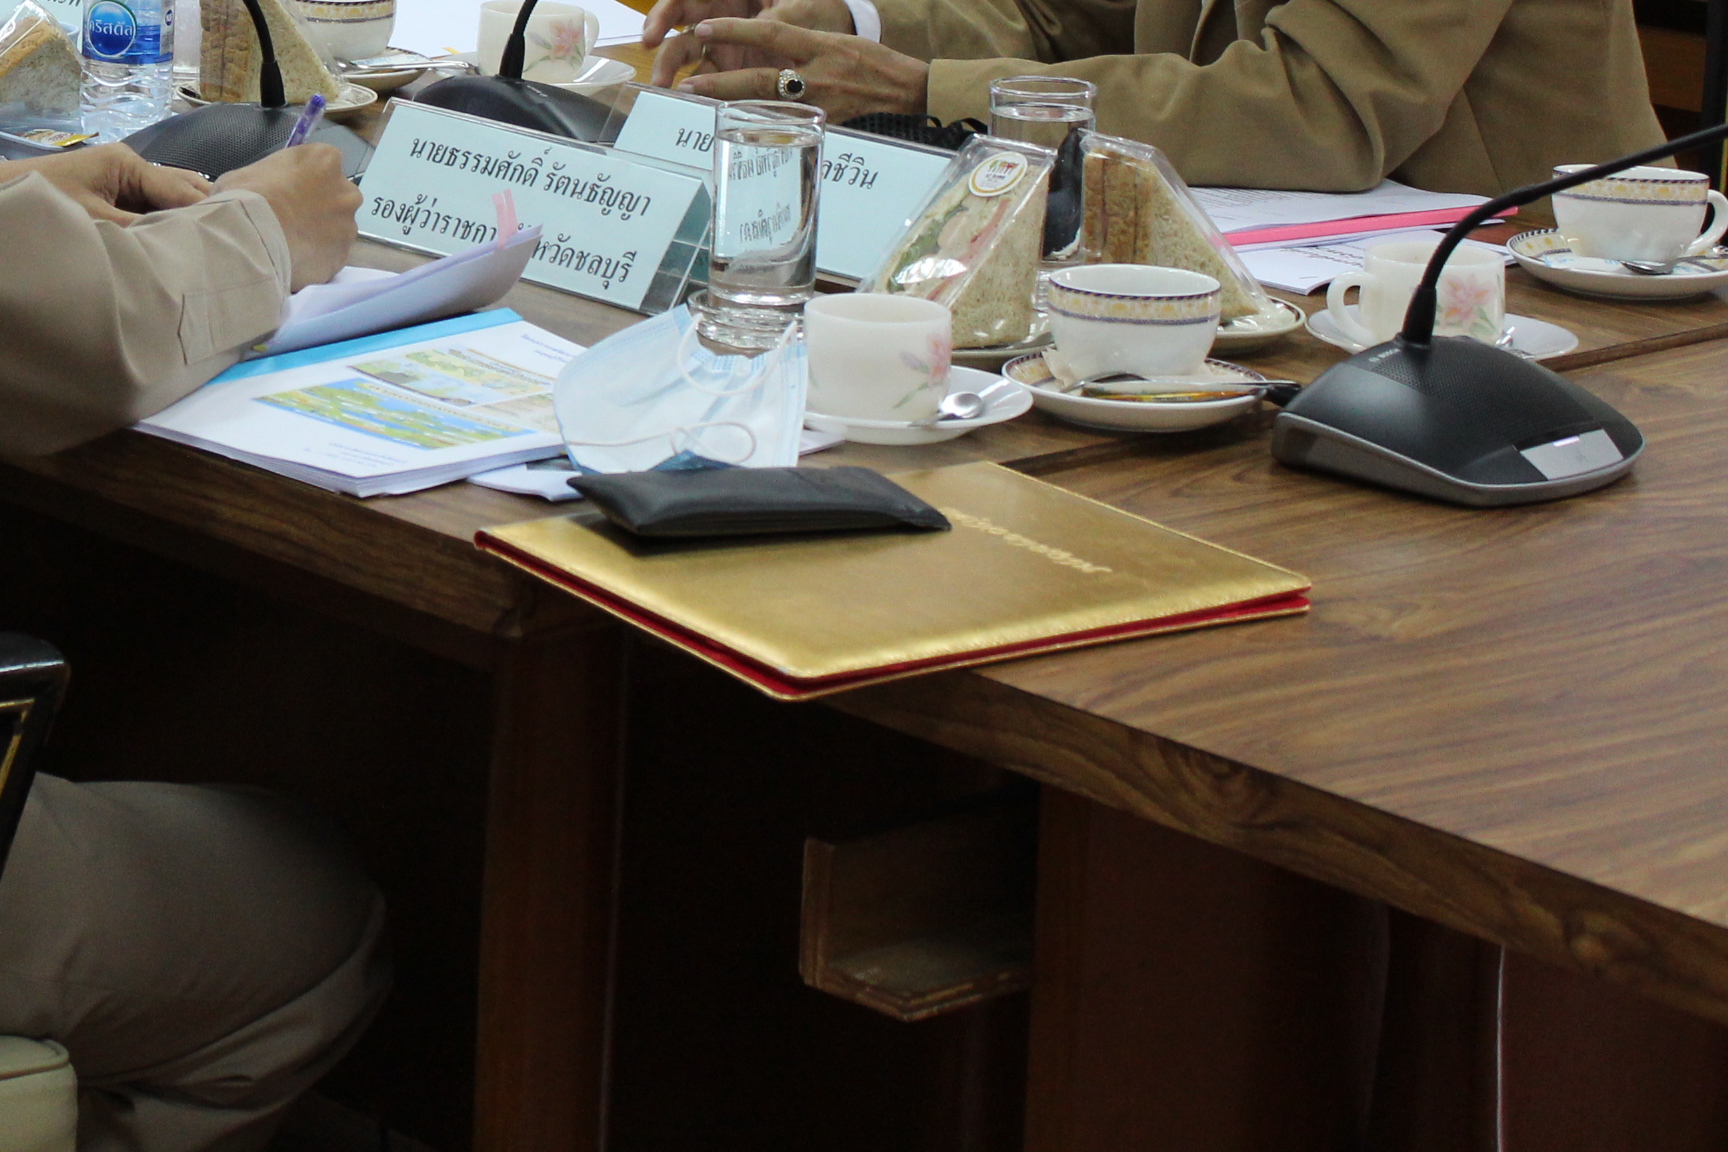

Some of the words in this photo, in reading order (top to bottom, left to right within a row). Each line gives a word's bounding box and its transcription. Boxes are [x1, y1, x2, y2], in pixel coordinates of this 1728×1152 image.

[410, 137, 553, 187] นายธรรมศักดิ์
[545, 162, 651, 221] รัตนธัญญา
[675, 128, 714, 152] นาย
[371, 194, 637, 289] รองผู้ว่าราชกาหวัดชลบุรี
